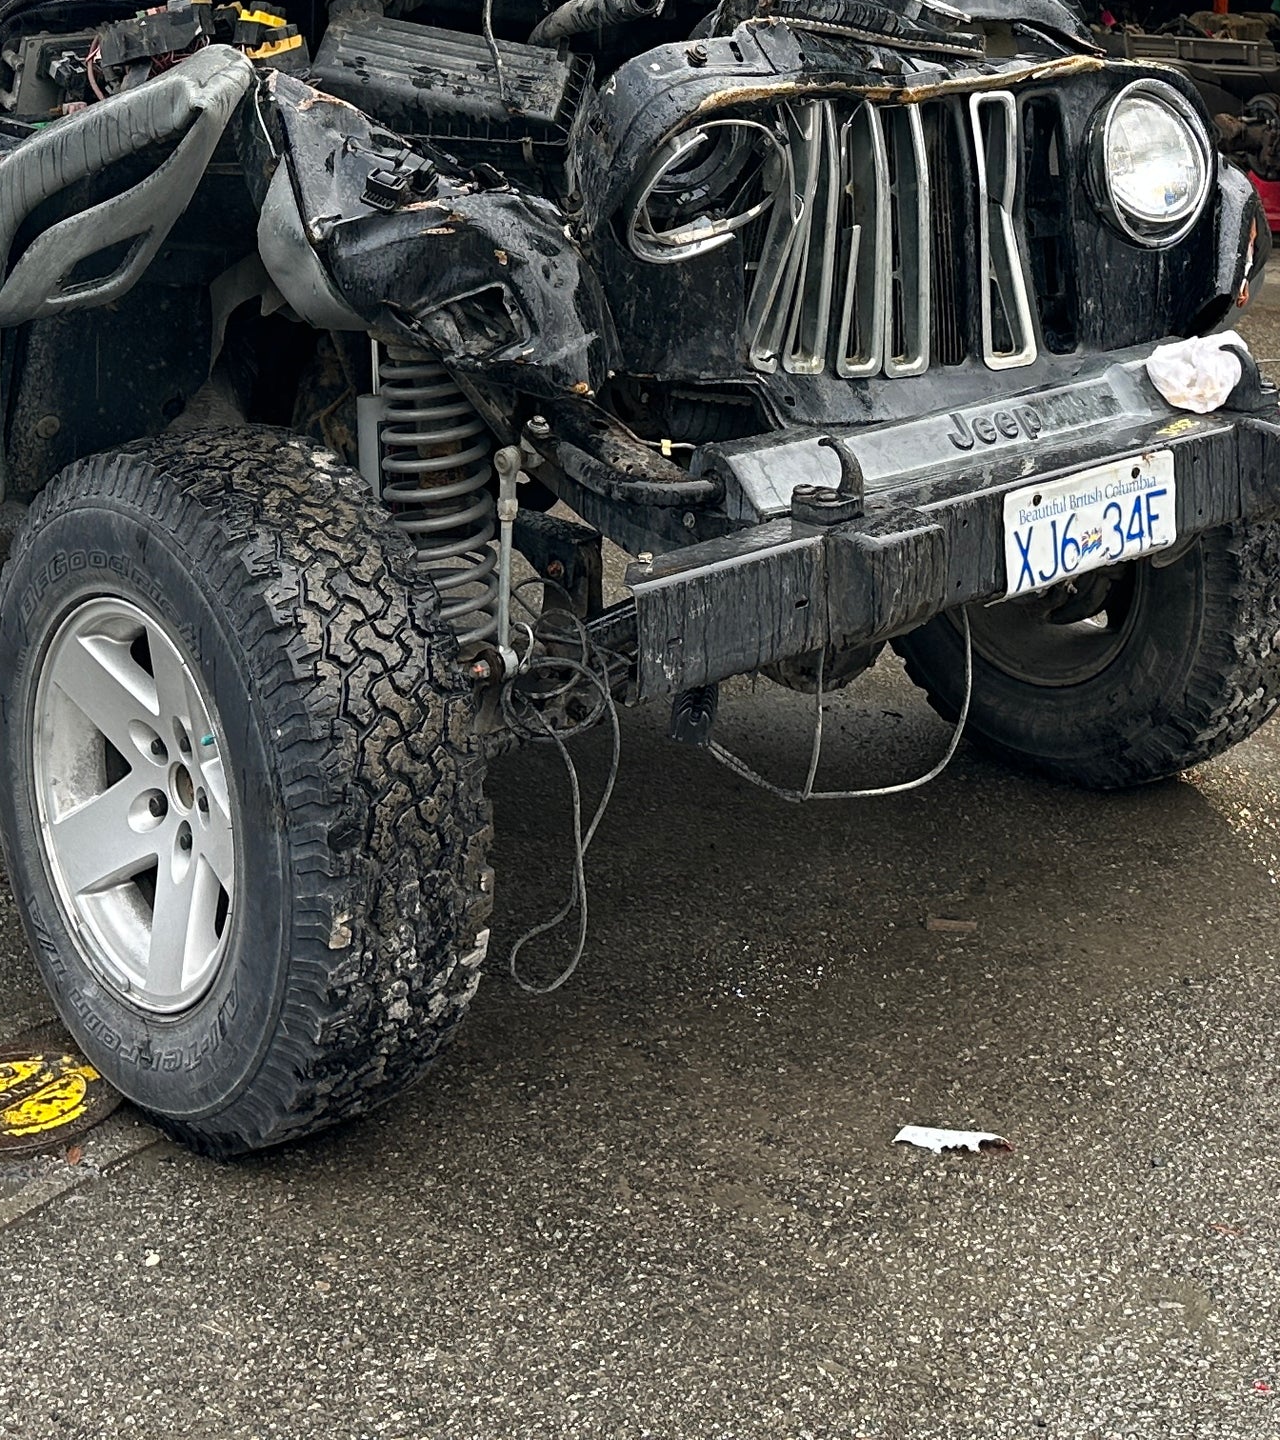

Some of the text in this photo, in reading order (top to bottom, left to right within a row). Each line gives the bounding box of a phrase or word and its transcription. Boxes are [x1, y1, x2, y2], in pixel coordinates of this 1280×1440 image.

[947, 405, 1042, 451] Jeep
[1019, 474, 1157, 526] Beautiful British Columbia
[1013, 512, 1082, 592] XJ6
